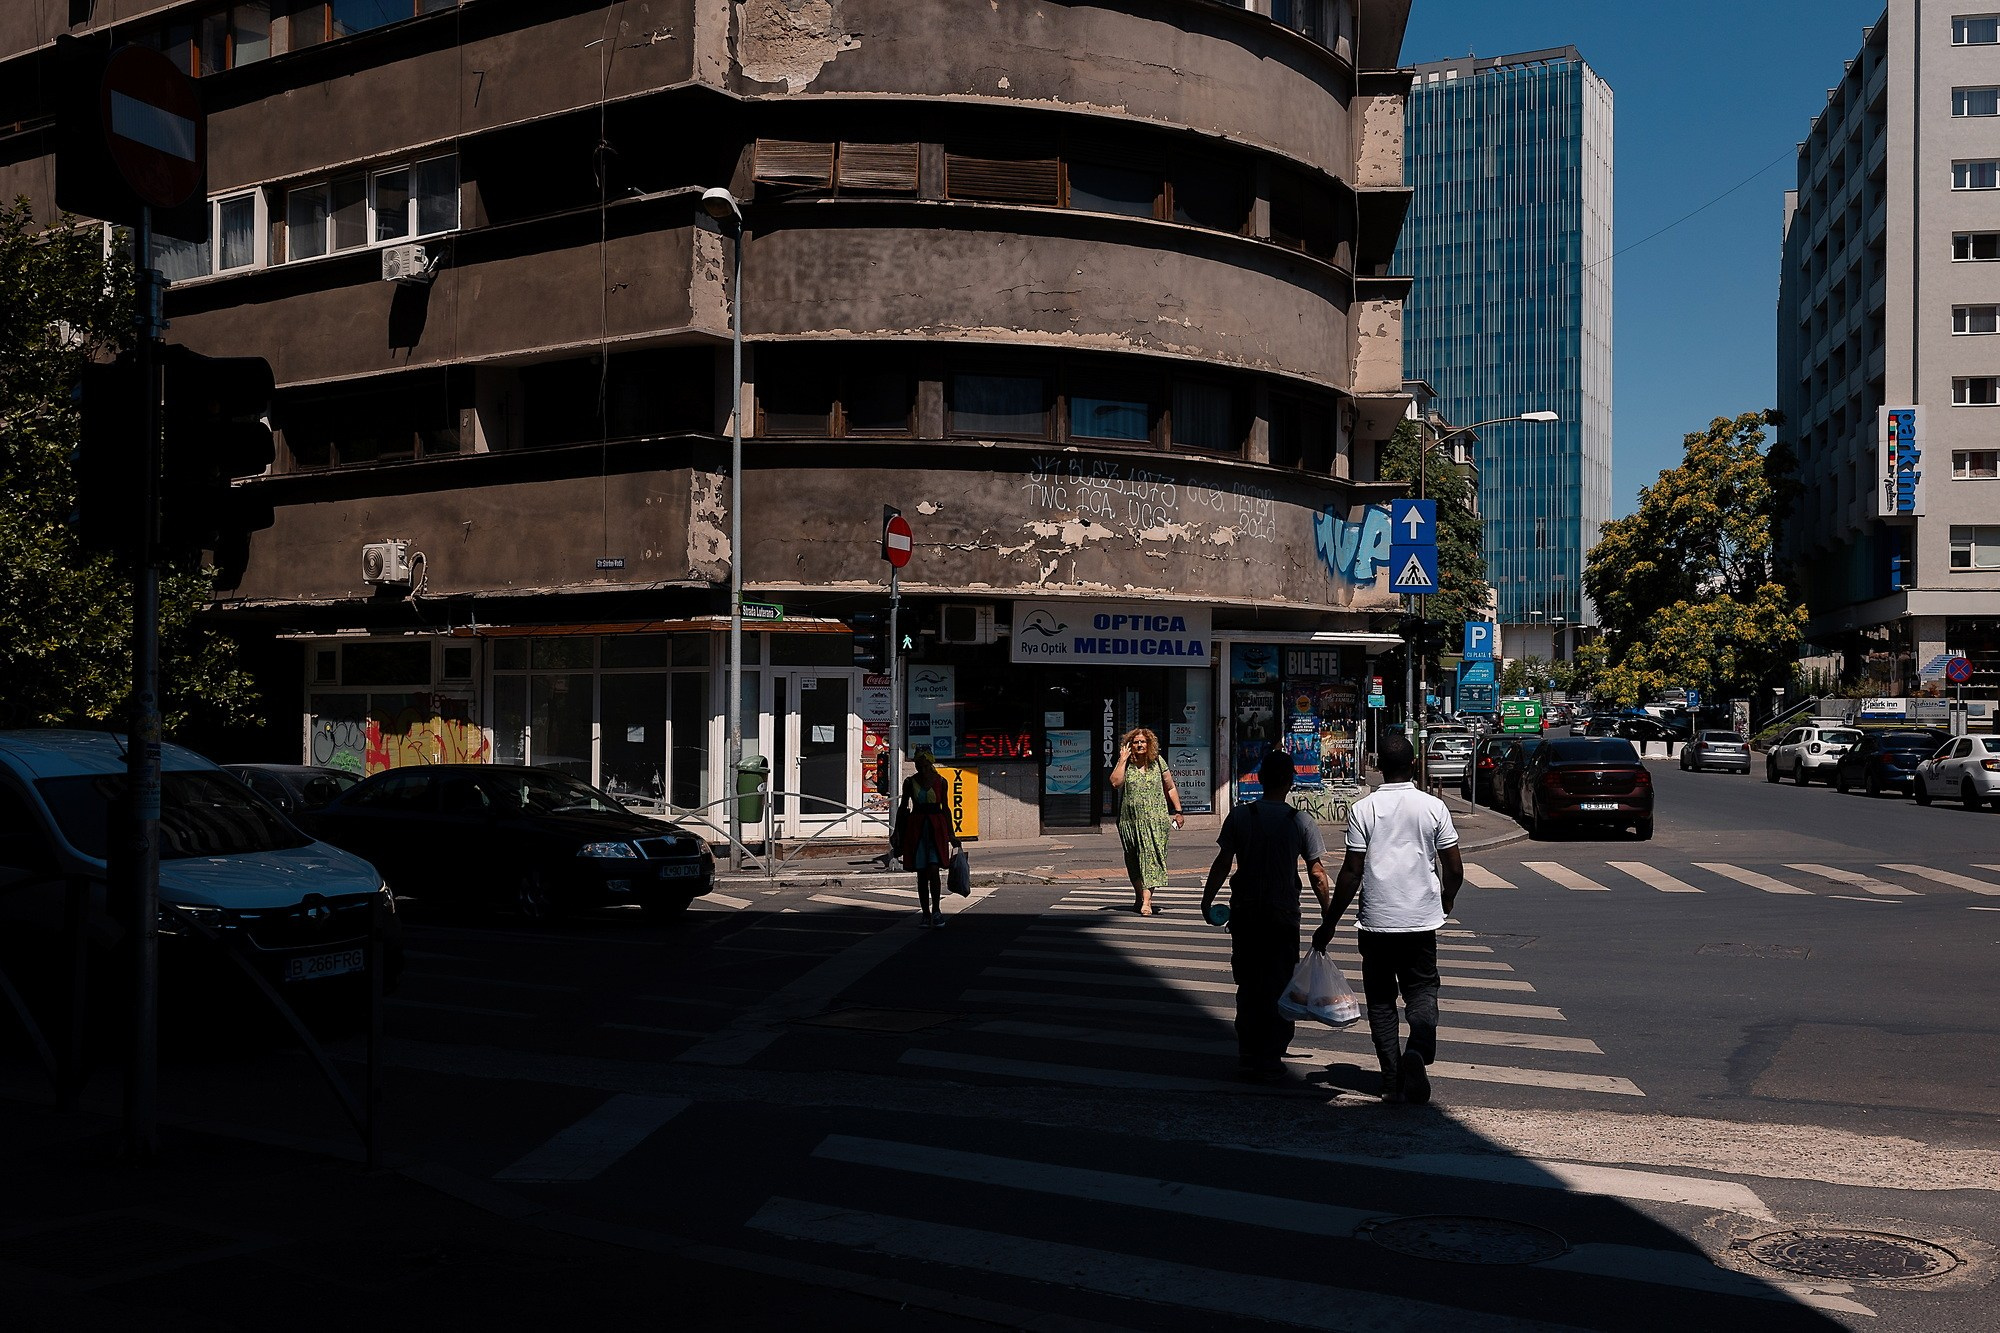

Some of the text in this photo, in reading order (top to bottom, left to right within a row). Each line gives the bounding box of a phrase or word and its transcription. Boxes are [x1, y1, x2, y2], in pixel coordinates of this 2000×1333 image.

[1093, 613, 1187, 632] OPTICA
[1074, 637, 1204, 656] MEDICALA
[1471, 626, 1487, 649] P
[1021, 642, 1067, 655] Rya Optik
[1288, 651, 1338, 675] BILETE
[1689, 692, 1696, 701] P
[1103, 698, 1114, 768] XEROX
[953, 769, 963, 833] XEROX
[292, 959, 303, 975] B
